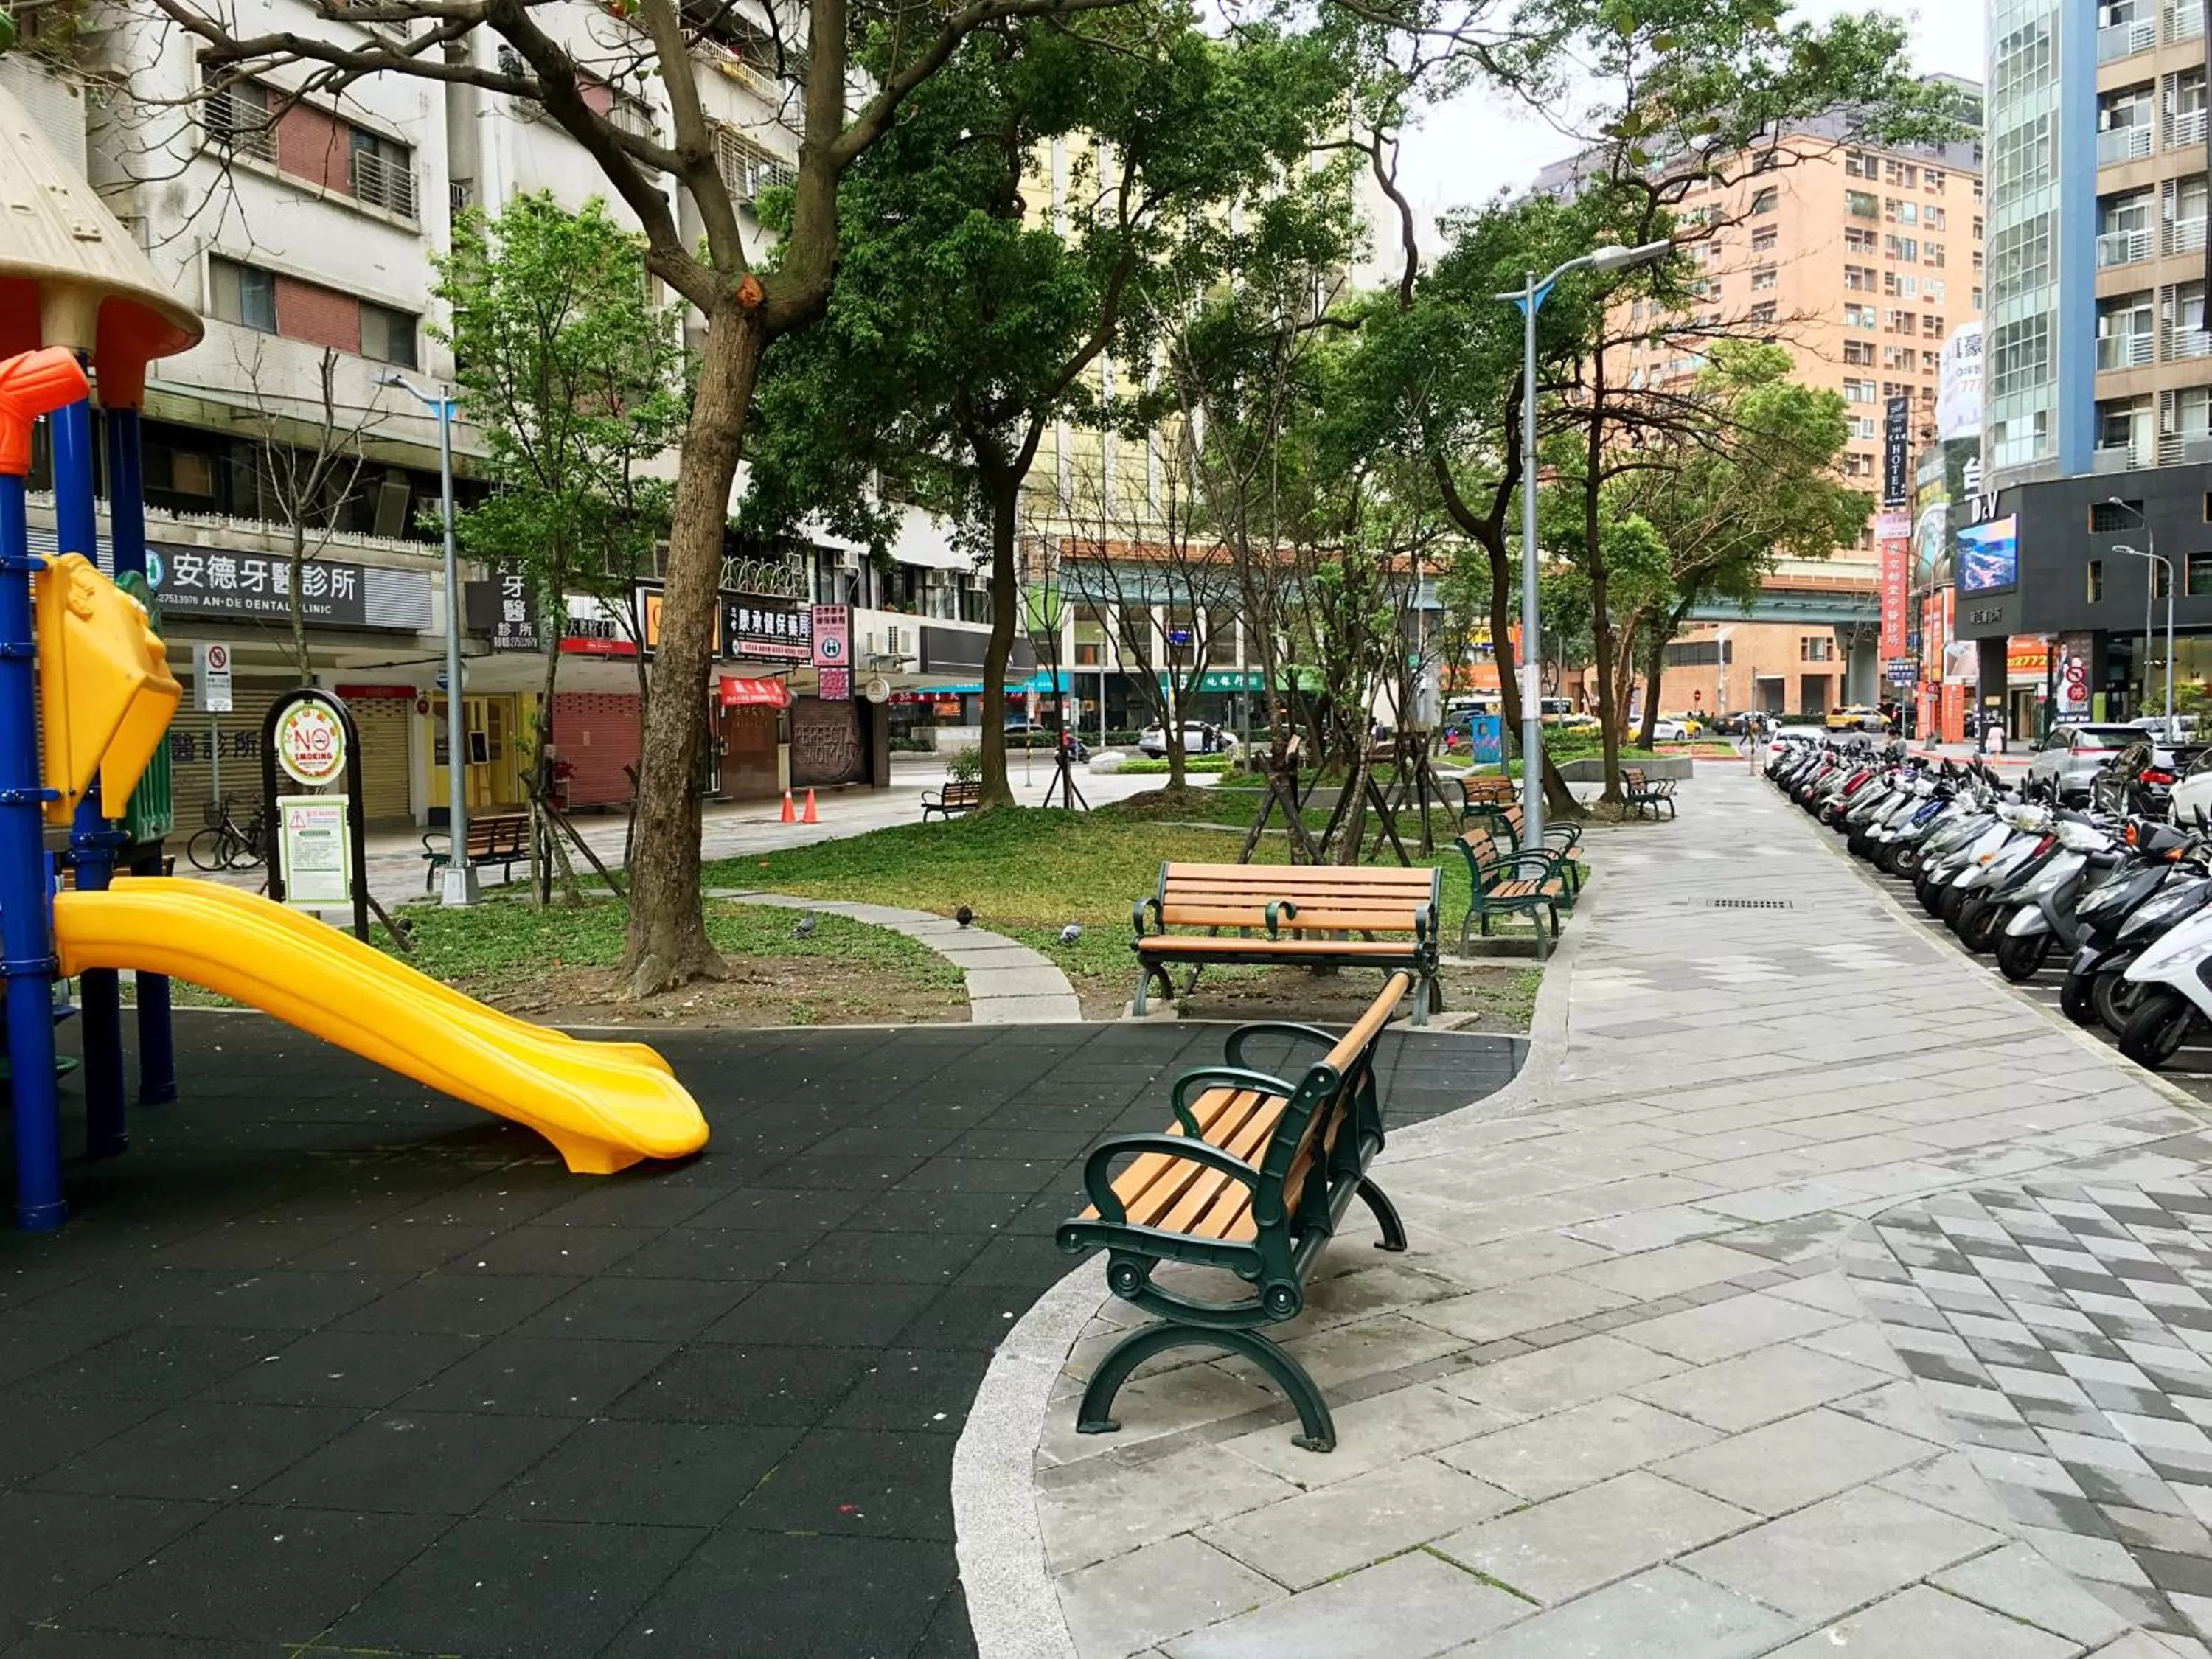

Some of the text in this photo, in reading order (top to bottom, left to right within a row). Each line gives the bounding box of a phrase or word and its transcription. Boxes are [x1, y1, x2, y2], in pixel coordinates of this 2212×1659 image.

[1891, 445, 1901, 496] HOTEL
[173, 553, 356, 600] 安德牙醫診所
[246, 598, 291, 611] DENTAL
[300, 604, 331, 614] LINIC
[295, 753, 332, 761] SMOKING
